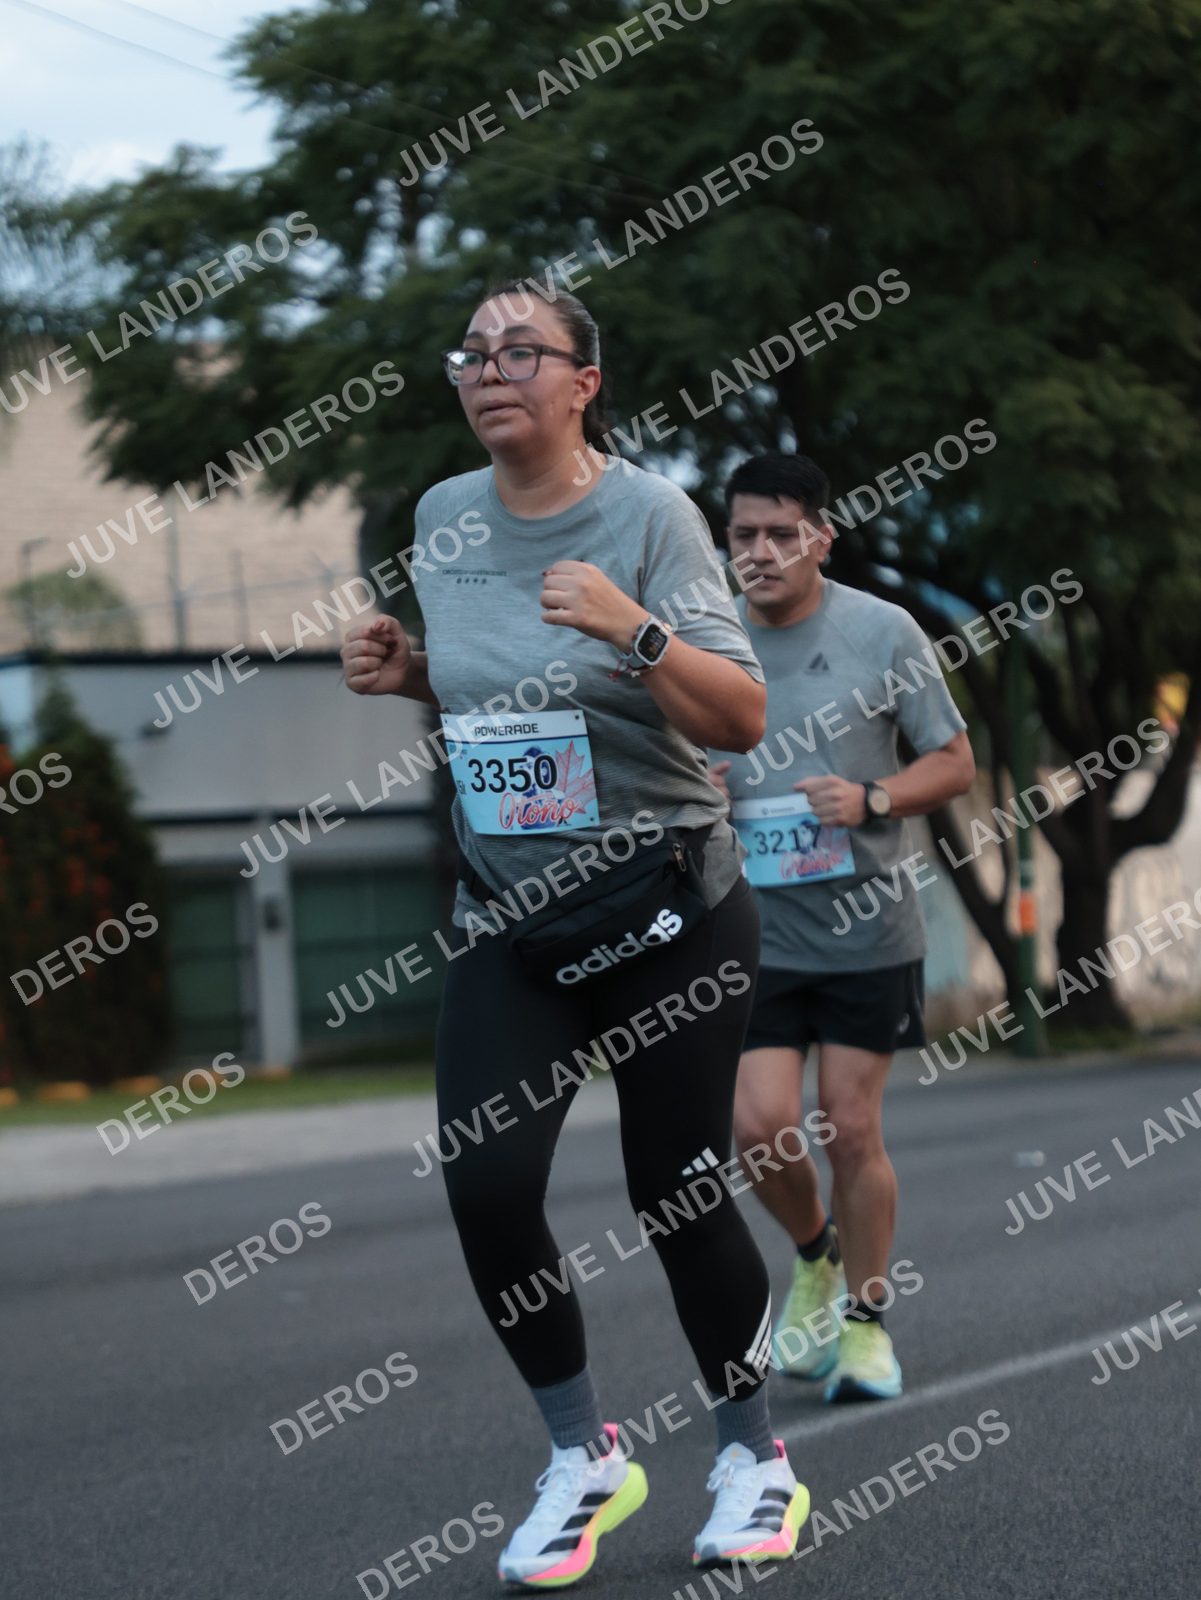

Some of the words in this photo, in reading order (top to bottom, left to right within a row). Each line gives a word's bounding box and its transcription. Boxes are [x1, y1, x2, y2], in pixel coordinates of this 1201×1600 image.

[474, 723, 540, 737] POWERADE
[468, 755, 558, 794] 3350
[754, 823, 821, 855] 3217
[556, 908, 683, 985] adidas
